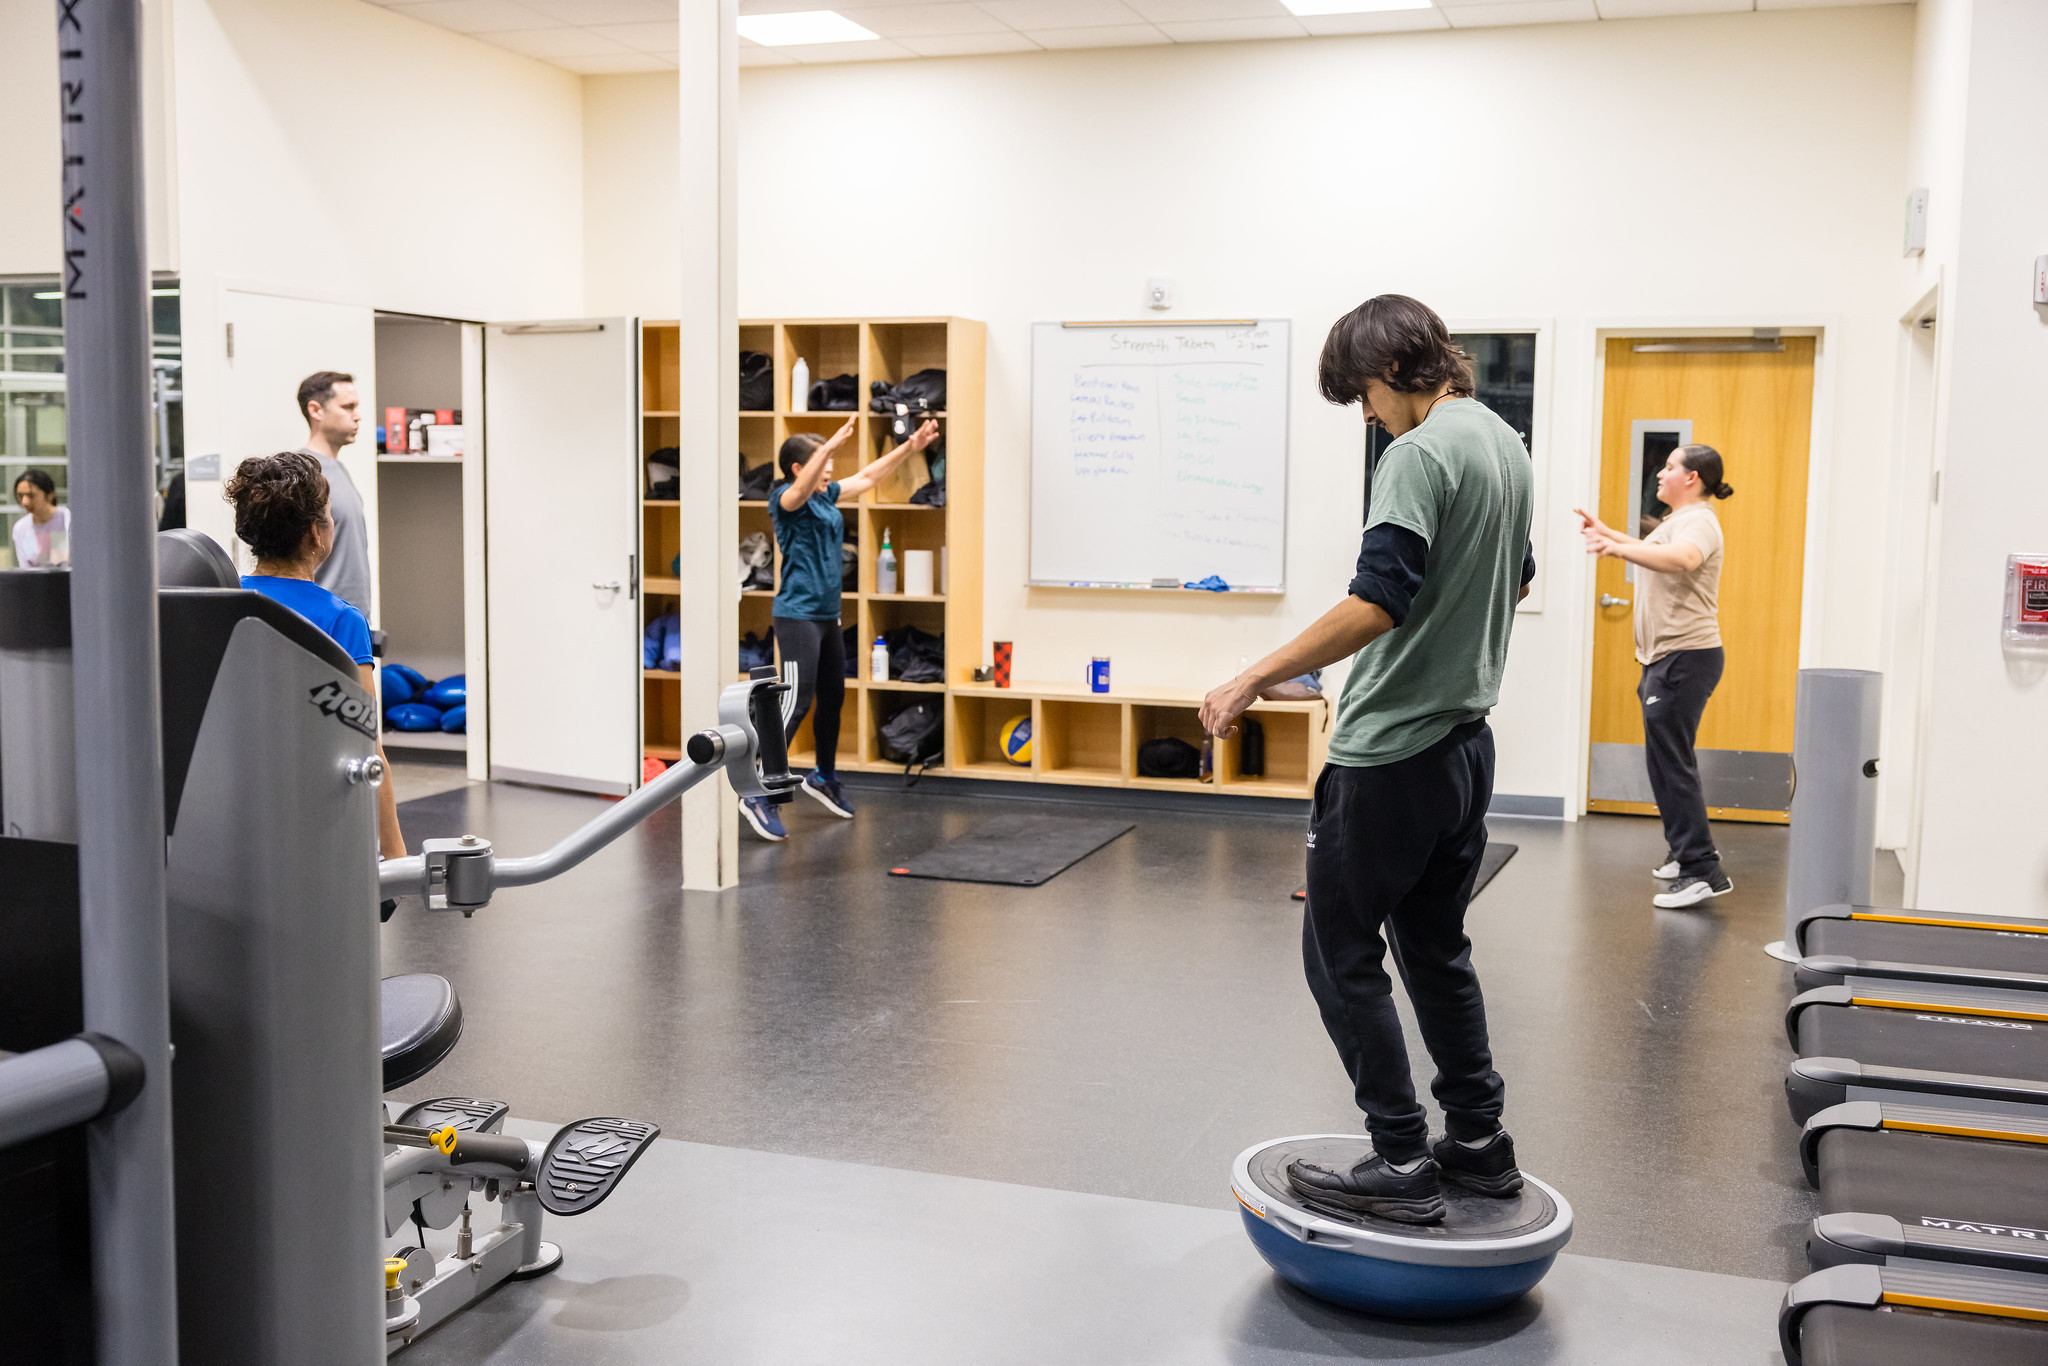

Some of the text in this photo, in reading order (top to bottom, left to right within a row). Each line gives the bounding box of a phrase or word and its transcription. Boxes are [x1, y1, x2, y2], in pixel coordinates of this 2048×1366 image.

[58, 0, 87, 299] MATRIX
[1110, 333, 1217, 353] Strength Tabata
[2025, 580, 2048, 590] FIR
[309, 682, 377, 732] HOIS
[1921, 1219, 2048, 1240] MATRI
